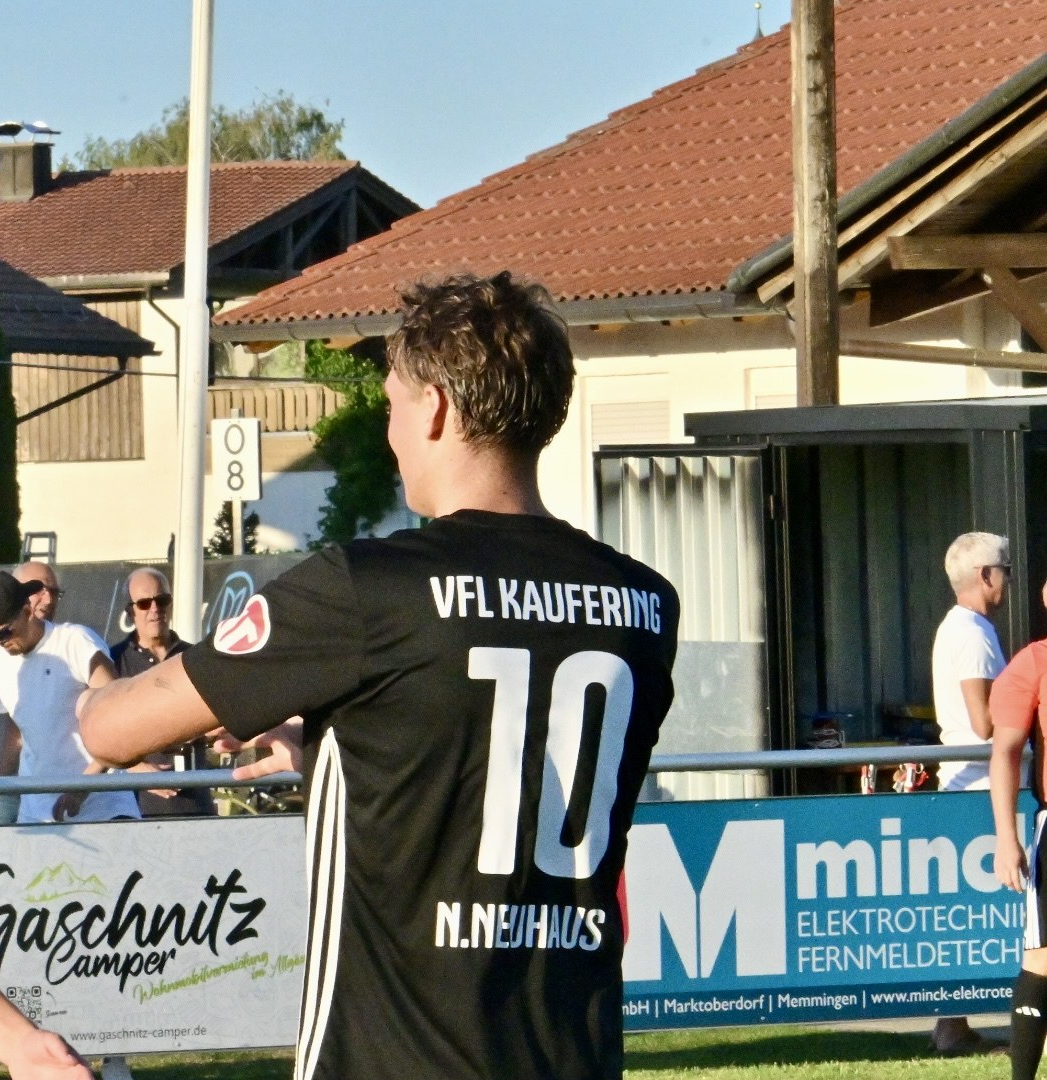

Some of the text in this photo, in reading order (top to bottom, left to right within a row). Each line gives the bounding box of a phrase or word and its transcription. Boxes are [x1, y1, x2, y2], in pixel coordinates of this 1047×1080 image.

[429, 575, 661, 634] VFL KAUFERING
[468, 647, 634, 880] 10
[435, 901, 605, 951] N.NEUHAUS
[45, 938, 177, 994] Camper
[797, 937, 1025, 974] FERNMELDETECH
[664, 994, 765, 1014] Marktoberdorf
[777, 992, 857, 1010] Memmingen
[70, 1025, 207, 1043] www.gaschnitz-camper.de
